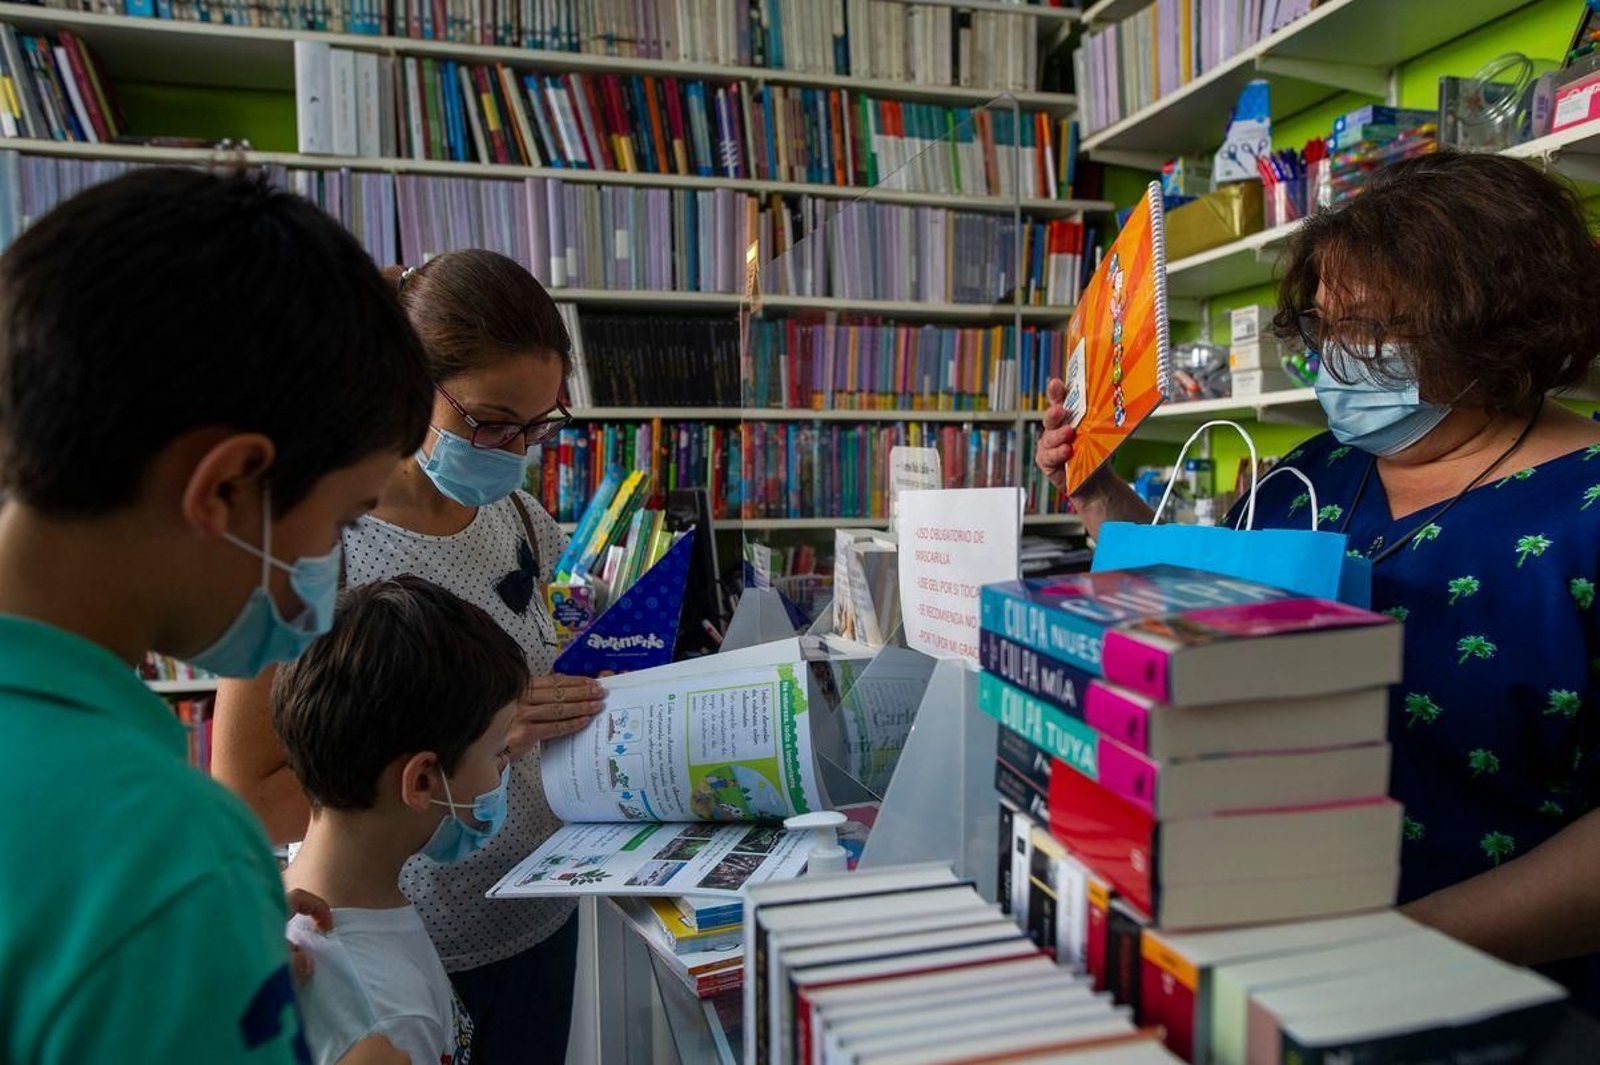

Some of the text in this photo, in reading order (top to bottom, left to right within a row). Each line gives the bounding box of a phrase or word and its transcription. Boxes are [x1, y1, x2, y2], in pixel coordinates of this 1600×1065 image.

[930, 527, 970, 543] OBLIGATORIO
[973, 529, 984, 544] DE
[915, 549, 950, 565] MASCARILLA
[928, 578, 939, 592] GEL
[926, 604, 963, 625] RECOMIENDA
[964, 613, 977, 629] NO
[1004, 597, 1049, 650] CULPA
[1051, 623, 1102, 664] NUES
[959, 642, 979, 660] GRAC
[1000, 638, 1039, 692] CULPA
[1041, 667, 1077, 709] MÍA
[1002, 686, 1043, 745] CULPA
[1045, 720, 1097, 777] TUYA
